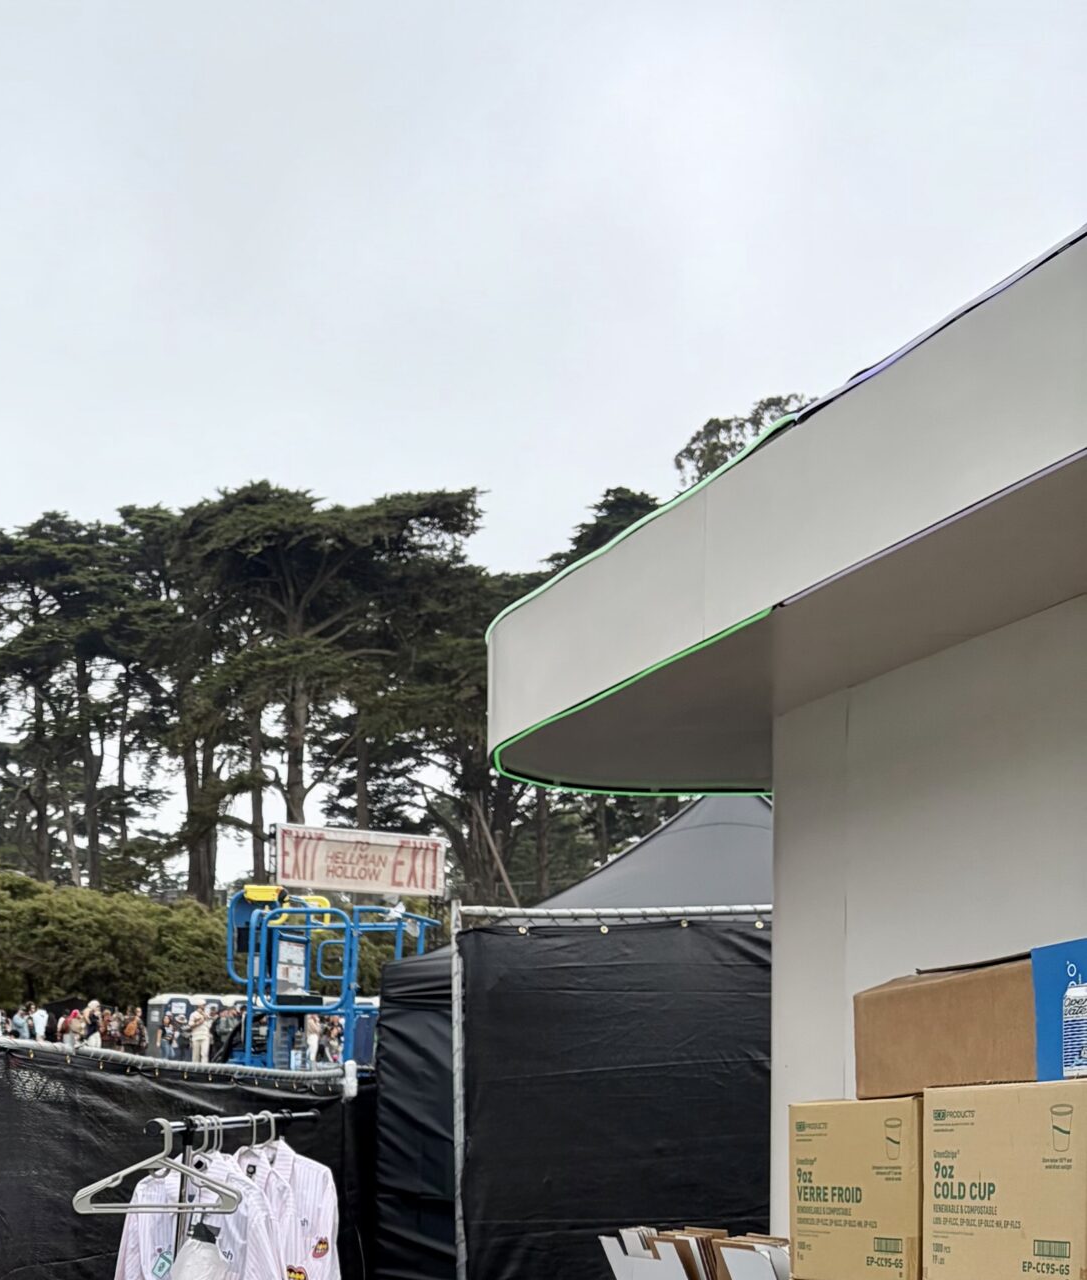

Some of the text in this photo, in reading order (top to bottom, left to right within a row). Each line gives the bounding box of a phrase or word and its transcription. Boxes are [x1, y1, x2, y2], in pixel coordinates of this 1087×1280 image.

[281, 829, 324, 879] EXIT
[326, 852, 388, 868] HELLMAN
[326, 864, 382, 880] HOLLOW
[391, 840, 441, 889] EXIT
[947, 1110, 975, 1119] PRODUCTS
[797, 1168, 813, 1183] 9oz
[934, 1161, 954, 1179] 9oz
[797, 1186, 862, 1203] VERRE FROID
[934, 1182, 996, 1200] COLD CUP
[1022, 1261, 1070, 1275] EP-CC9S-GS
